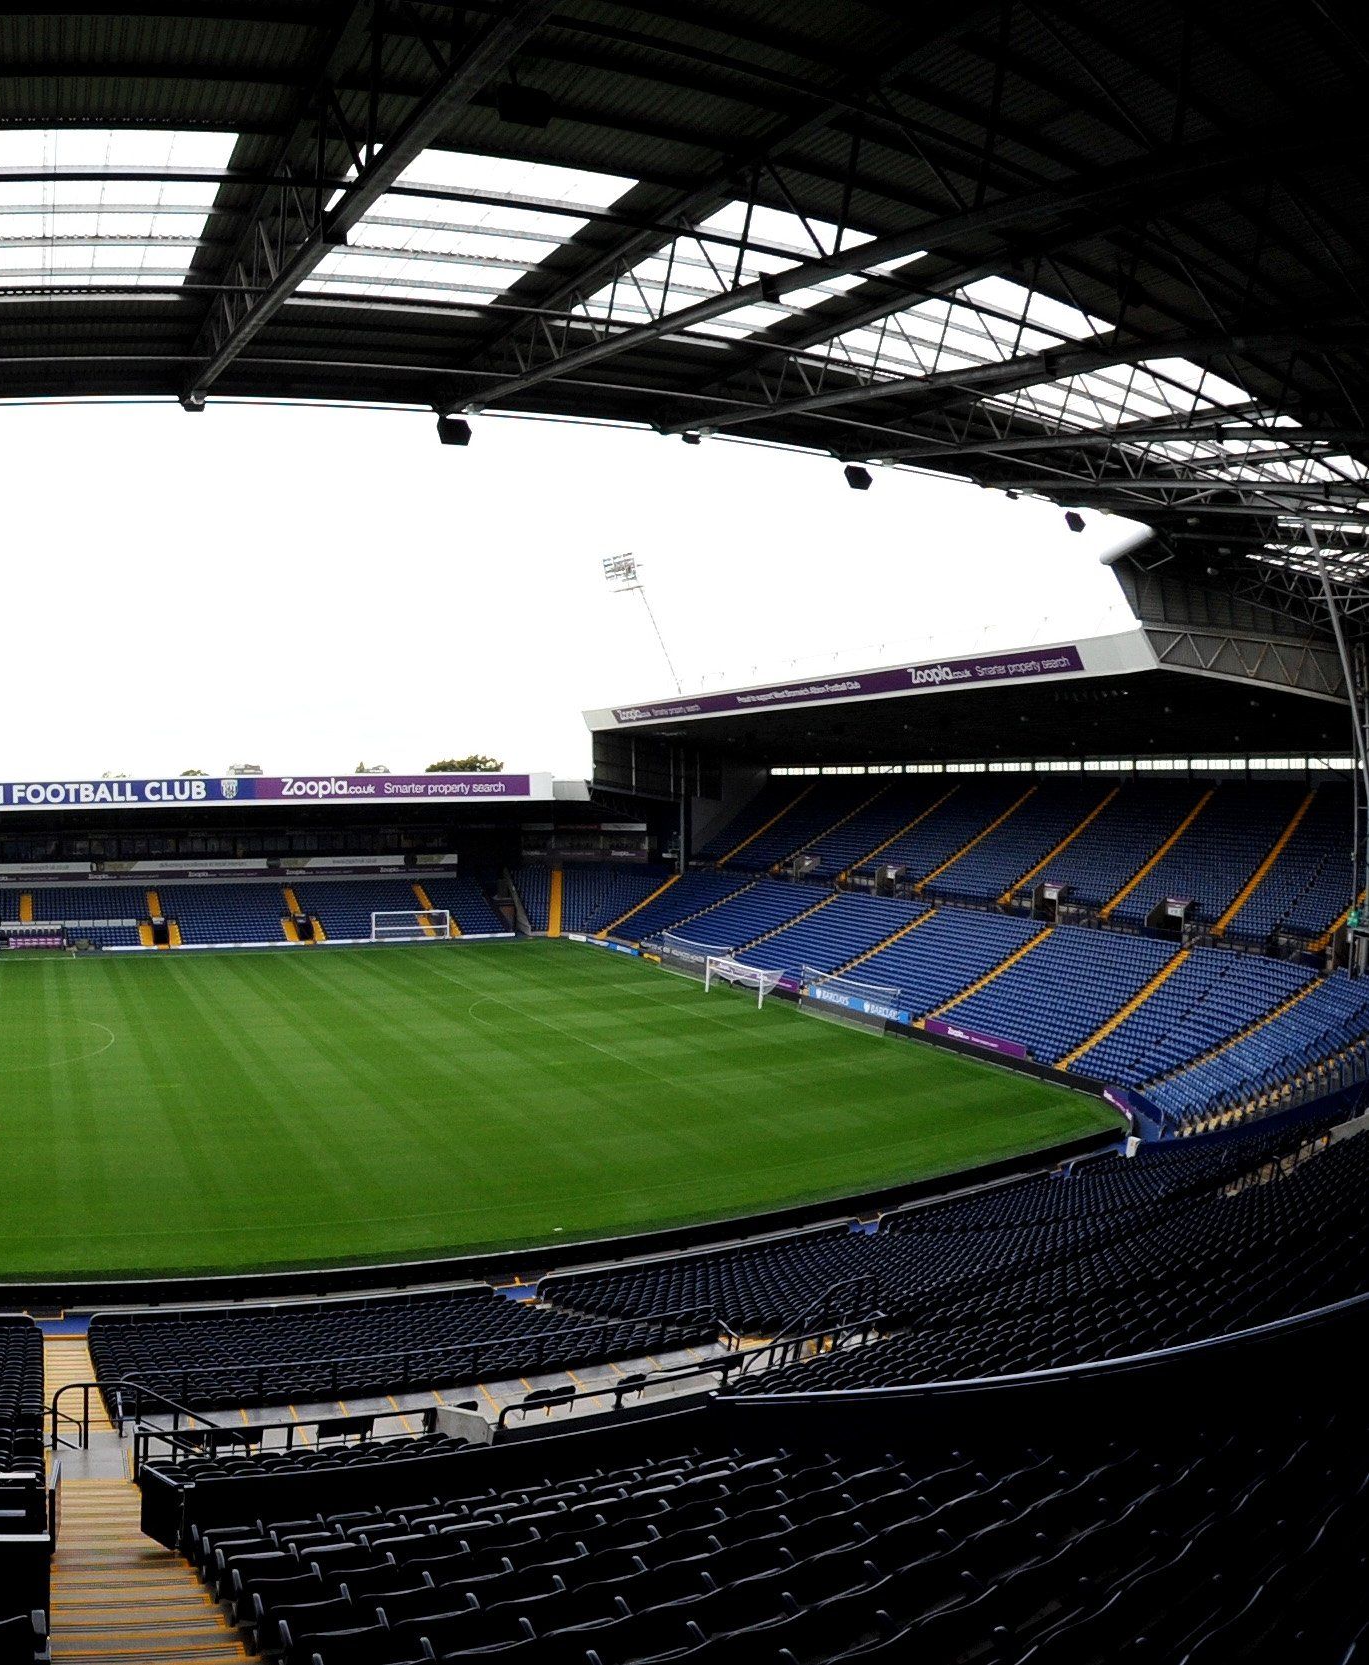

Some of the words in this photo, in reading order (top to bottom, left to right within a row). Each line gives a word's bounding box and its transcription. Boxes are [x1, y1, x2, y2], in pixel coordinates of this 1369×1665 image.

[1007, 661, 1041, 676] property
[1041, 656, 1071, 670] search
[13, 783, 138, 804] FOOTBALL
[145, 781, 207, 802] CLUB
[281, 777, 376, 799] Zoopla.co.uk
[384, 782, 427, 794] Smarter
[427, 782, 470, 796] property
[472, 780, 506, 793] search
